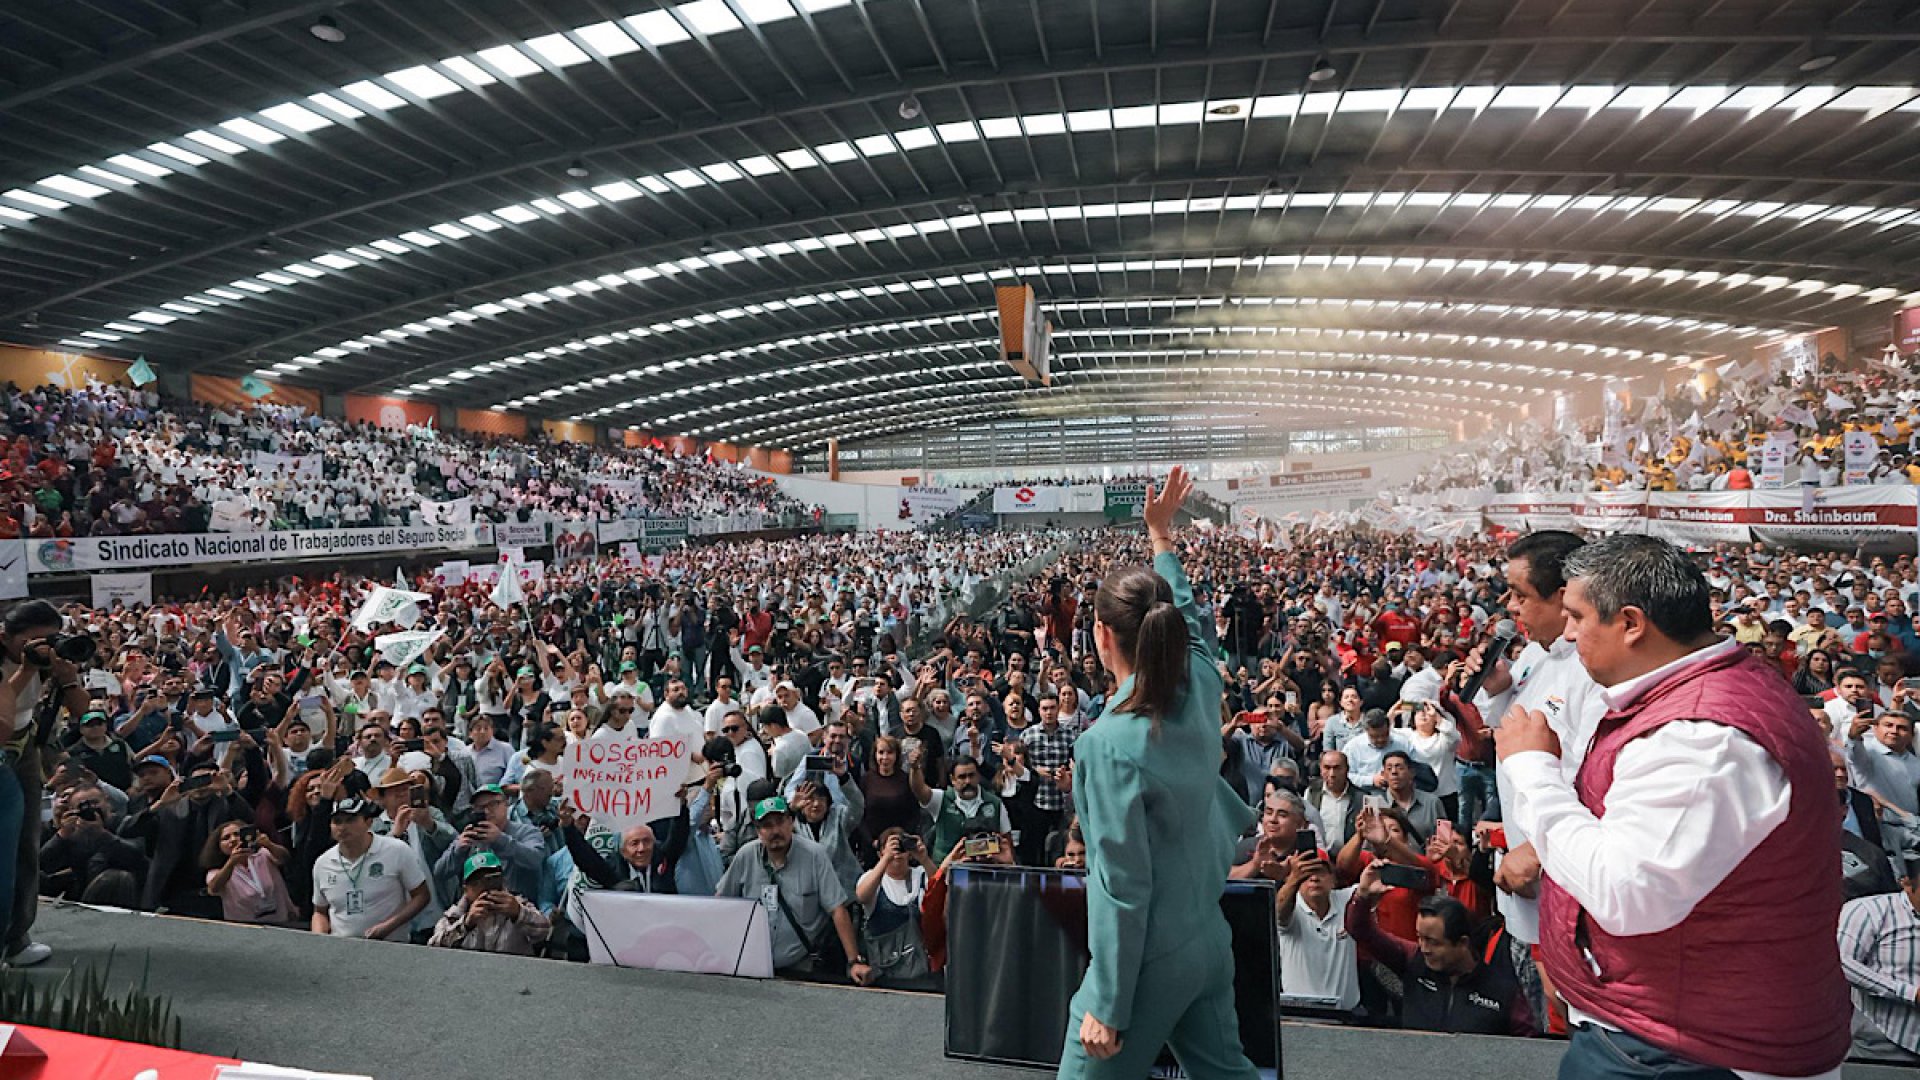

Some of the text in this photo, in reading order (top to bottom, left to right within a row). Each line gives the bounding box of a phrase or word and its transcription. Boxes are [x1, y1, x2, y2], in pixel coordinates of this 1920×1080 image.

[1764, 509, 1877, 523] Dra. Sheinbaum
[98, 527, 466, 561] Sindicato Nacional de Trabajadores del Seguro Social
[573, 765, 668, 784] INGENIERIA
[573, 787, 651, 817] UNAM
